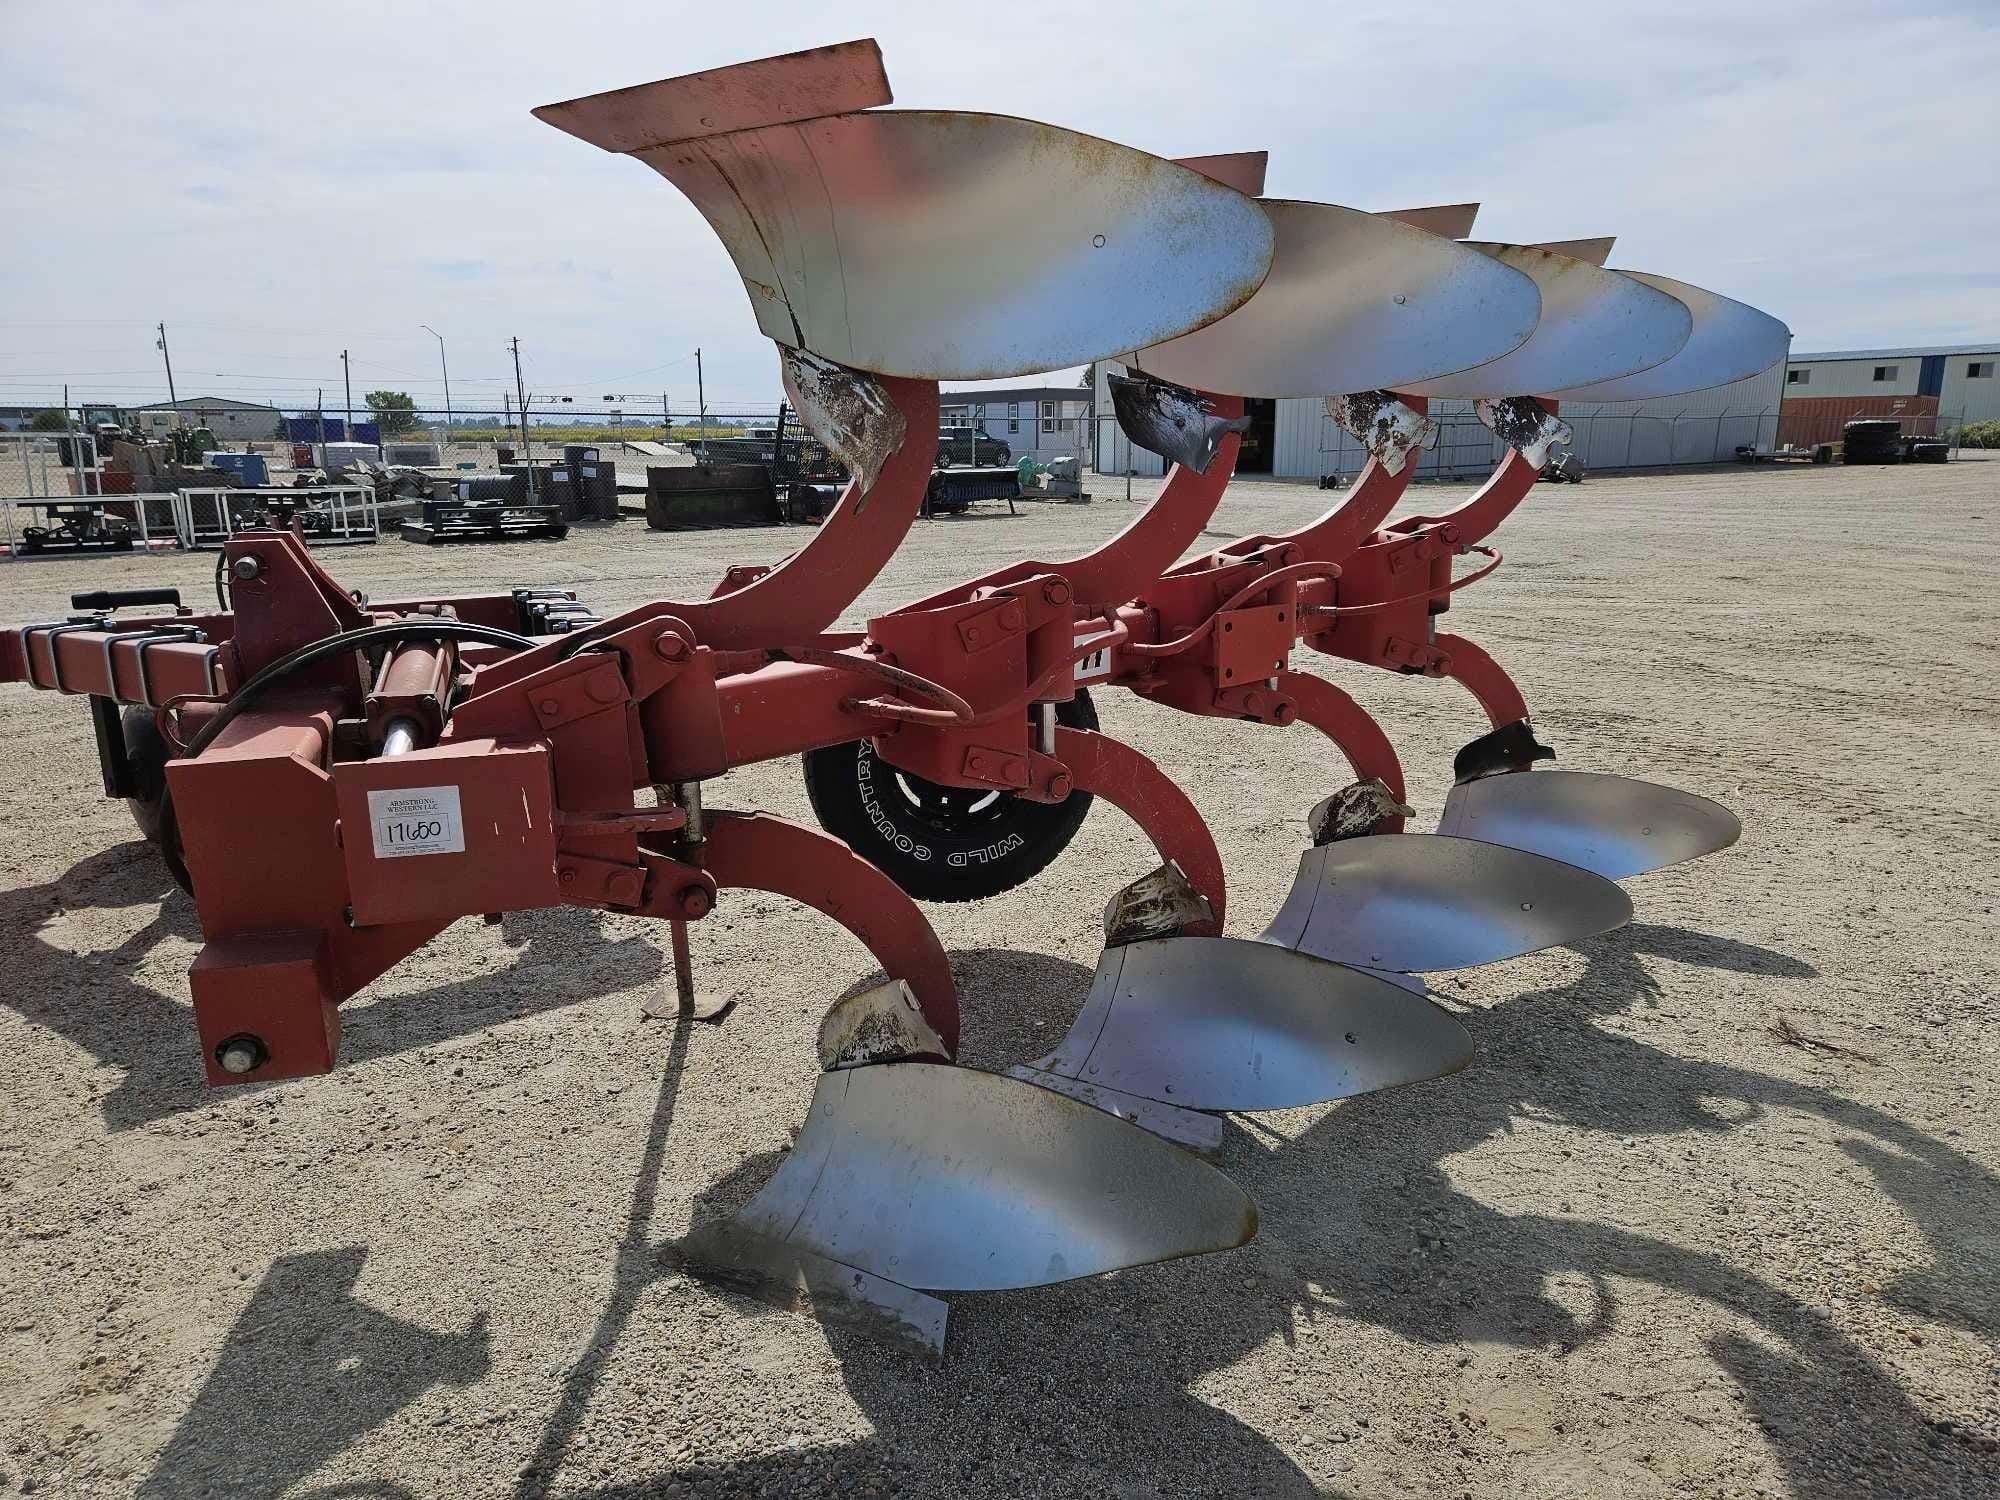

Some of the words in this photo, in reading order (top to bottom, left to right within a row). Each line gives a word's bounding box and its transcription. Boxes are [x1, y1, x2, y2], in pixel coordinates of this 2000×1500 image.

[387, 804, 423, 813] WESTERN
[424, 803, 438, 811] LLC
[390, 798, 434, 807] ARMSTRONG
[858, 738, 932, 862] COUNTRY
[388, 821, 441, 843] 17650
[947, 833, 1024, 867] WILD
